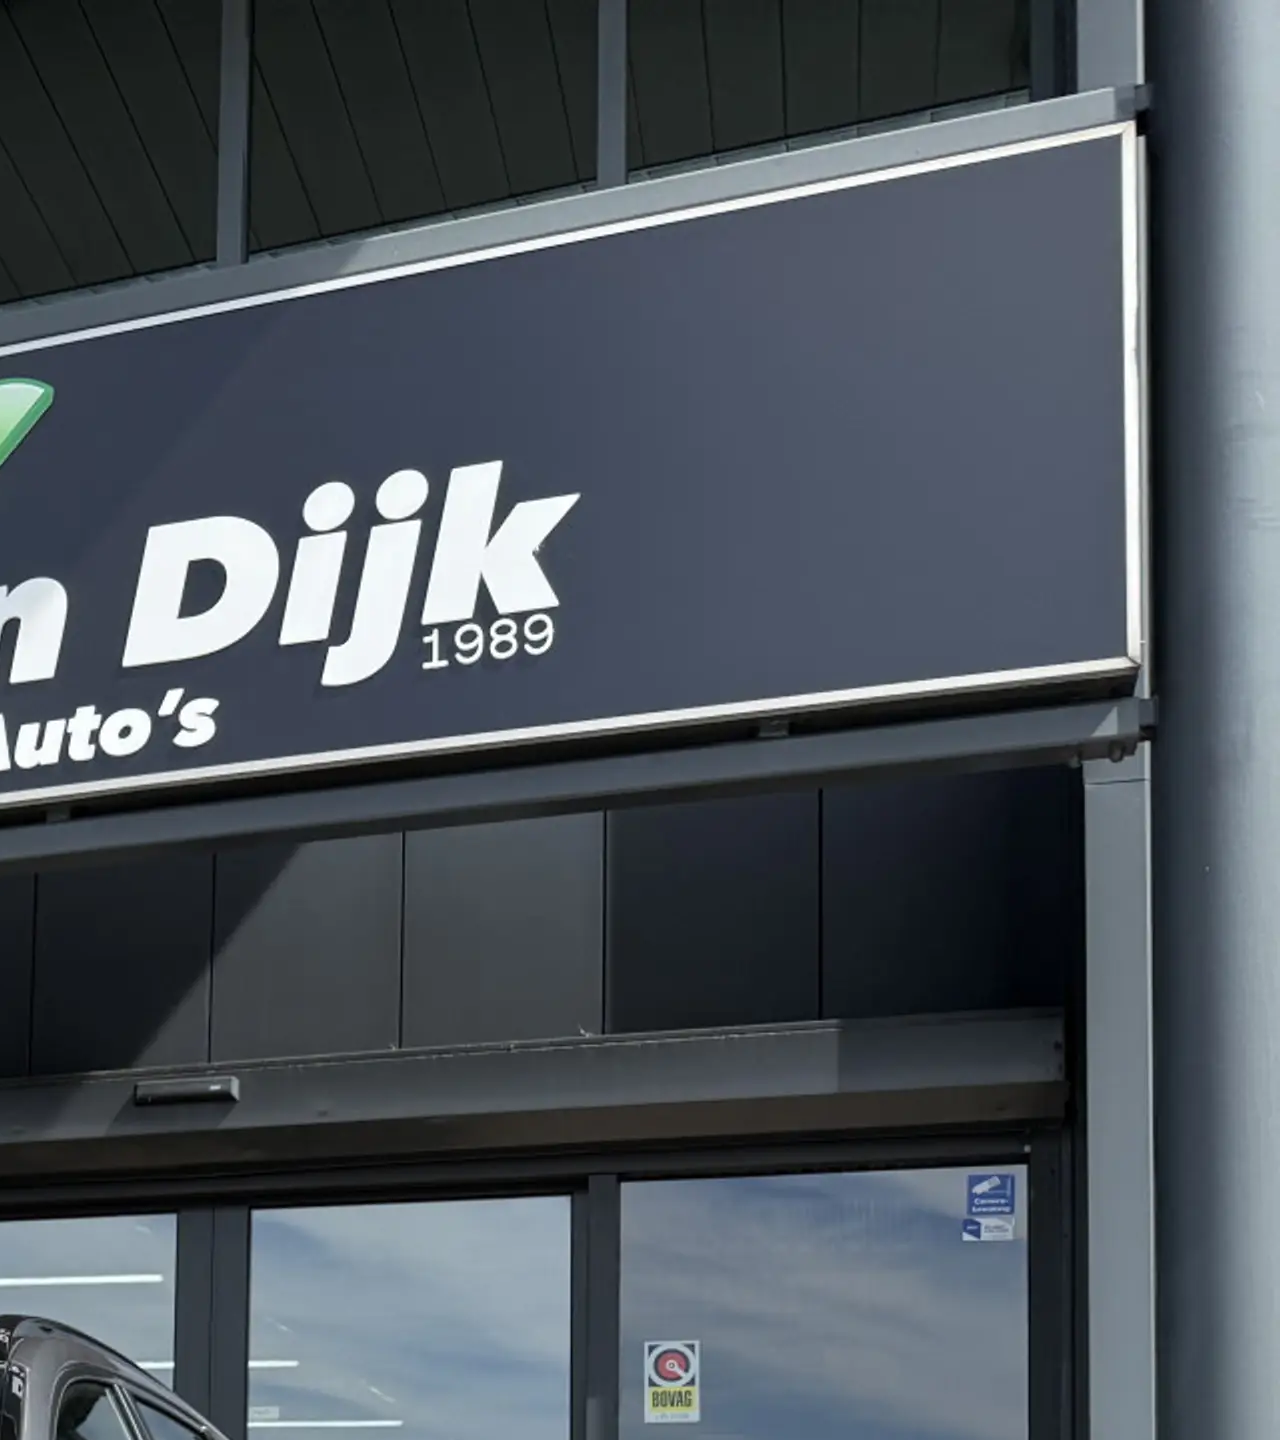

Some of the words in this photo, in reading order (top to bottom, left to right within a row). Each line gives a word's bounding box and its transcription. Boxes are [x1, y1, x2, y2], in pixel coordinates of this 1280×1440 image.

[122, 460, 581, 687] Dijk
[420, 614, 555, 671] 1989
[652, 1389, 693, 1408] BOVAG
